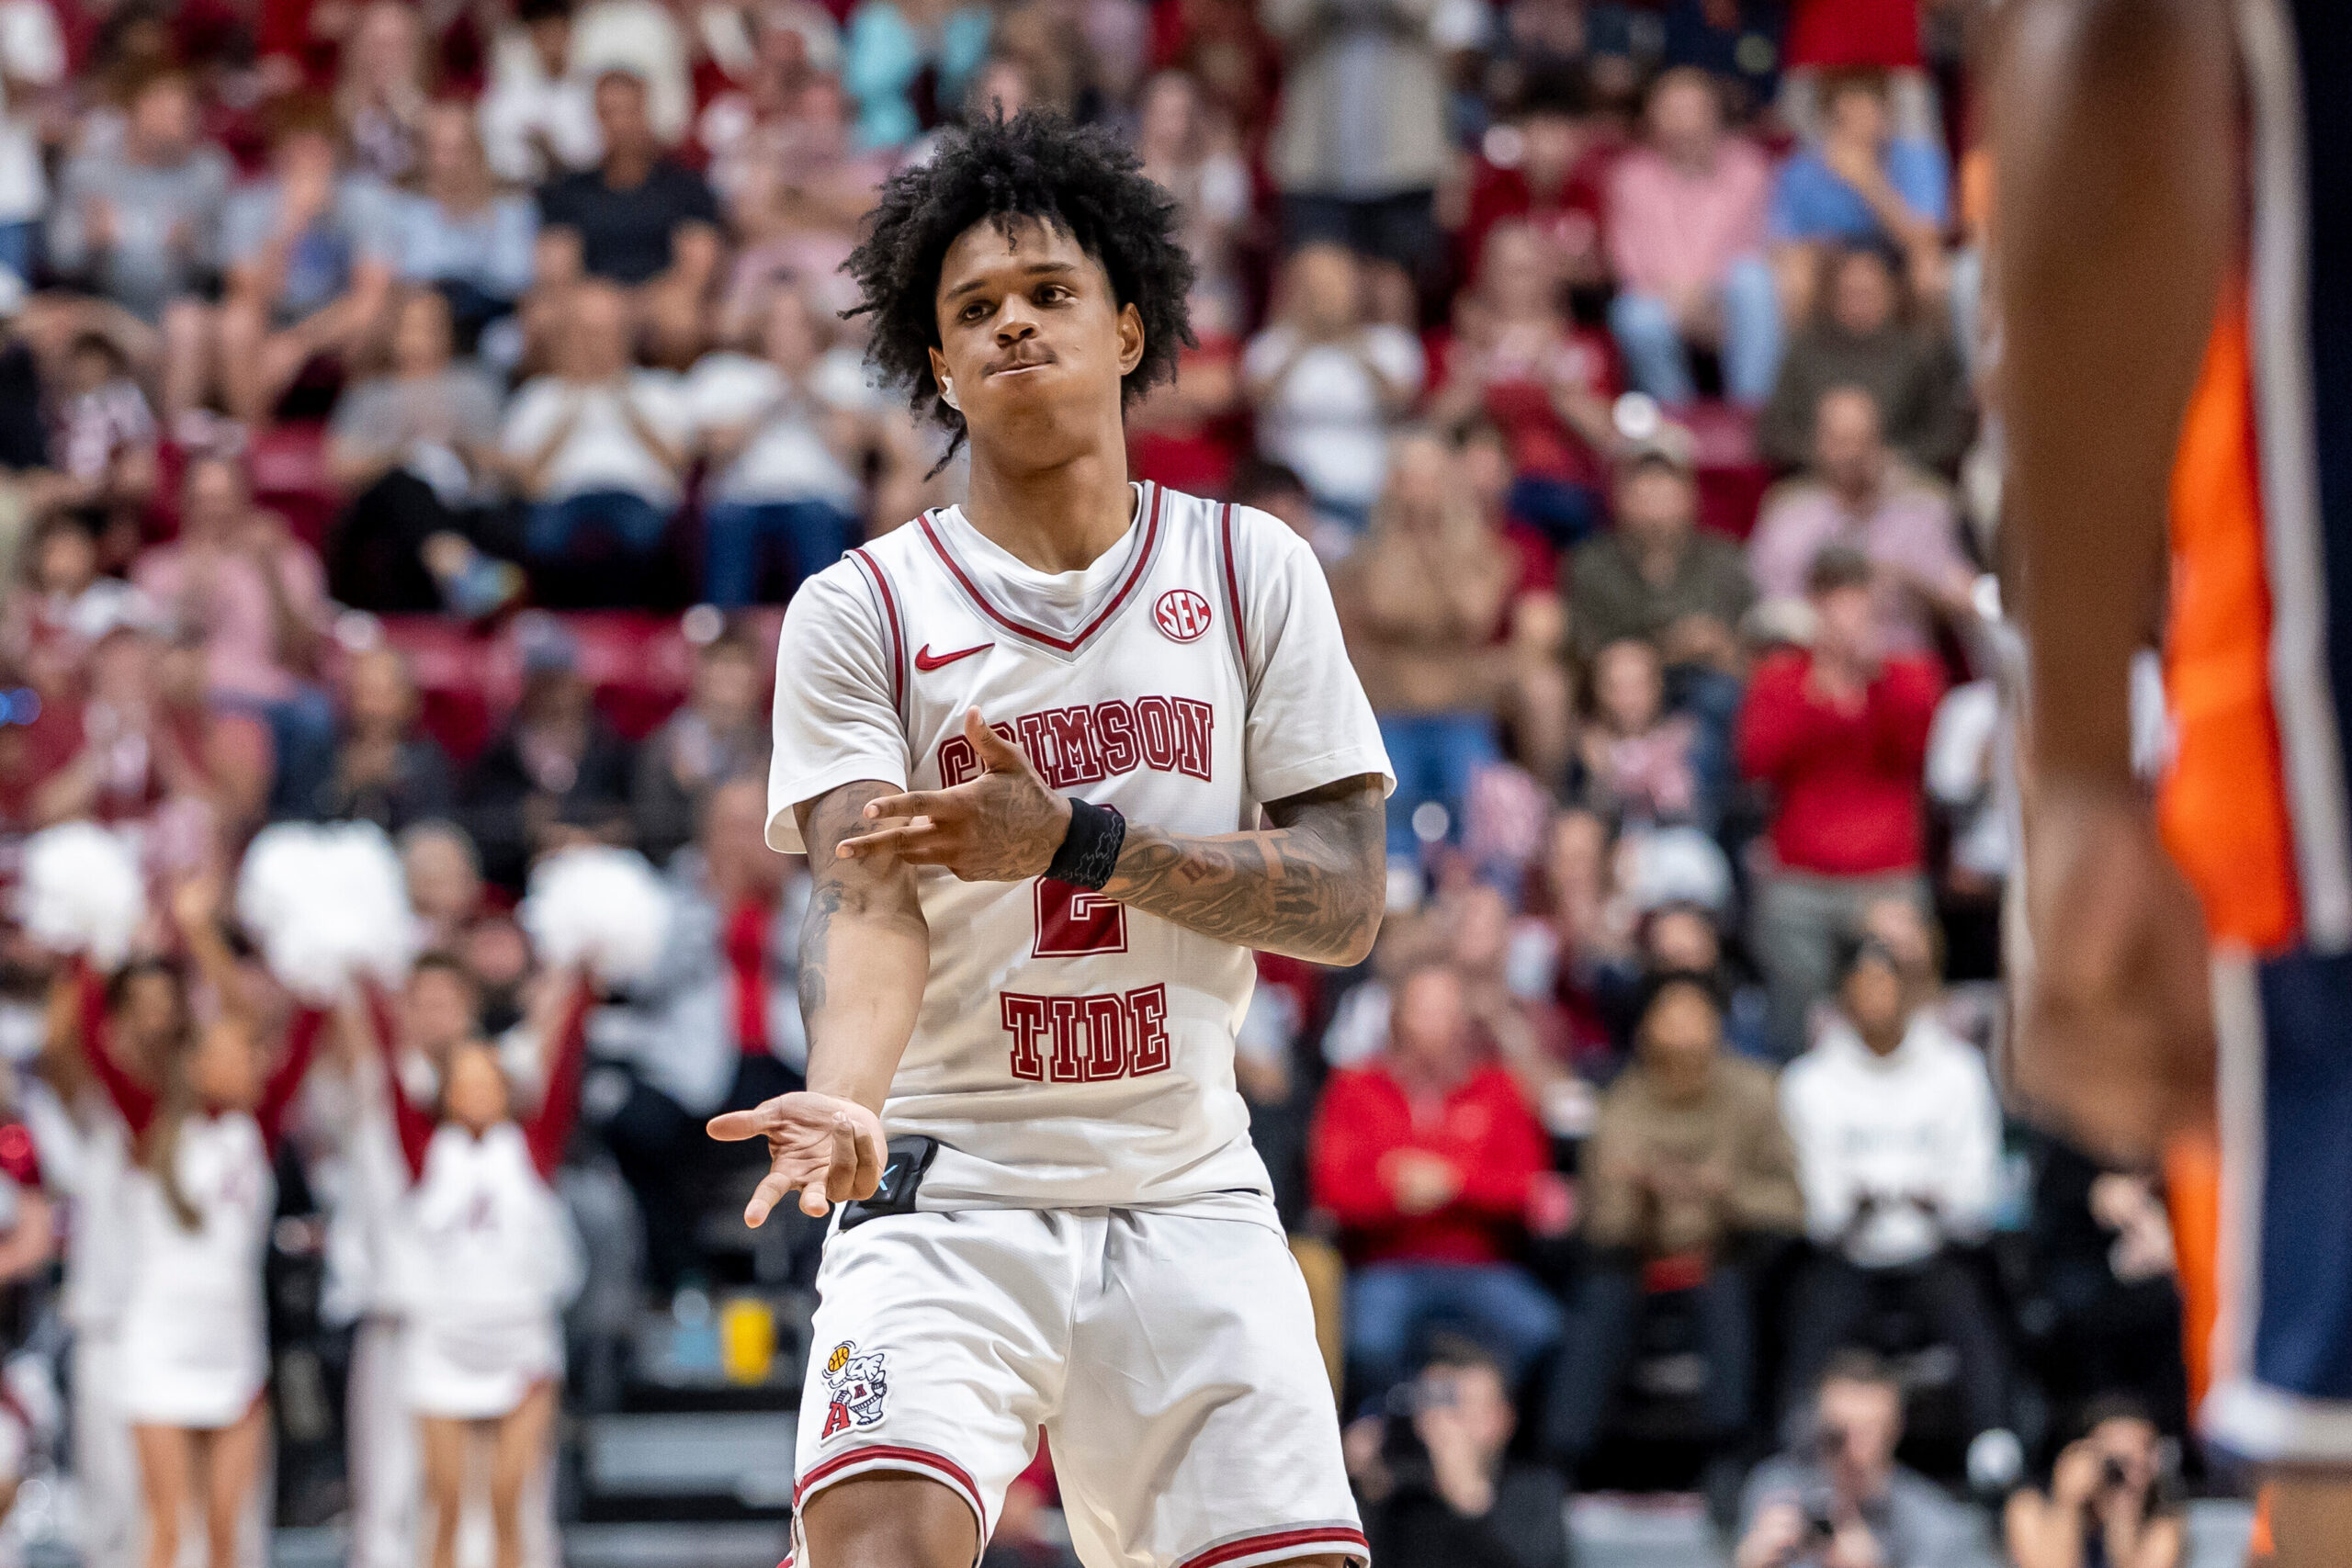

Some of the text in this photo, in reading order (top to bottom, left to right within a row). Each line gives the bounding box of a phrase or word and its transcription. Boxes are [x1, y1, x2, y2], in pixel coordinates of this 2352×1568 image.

[1157, 592, 1209, 637] SEC
[938, 695, 1214, 789] CIMSON
[1000, 982, 1170, 1083] TIDE
[854, 1384, 867, 1399] A
[821, 1402, 851, 1439] A
